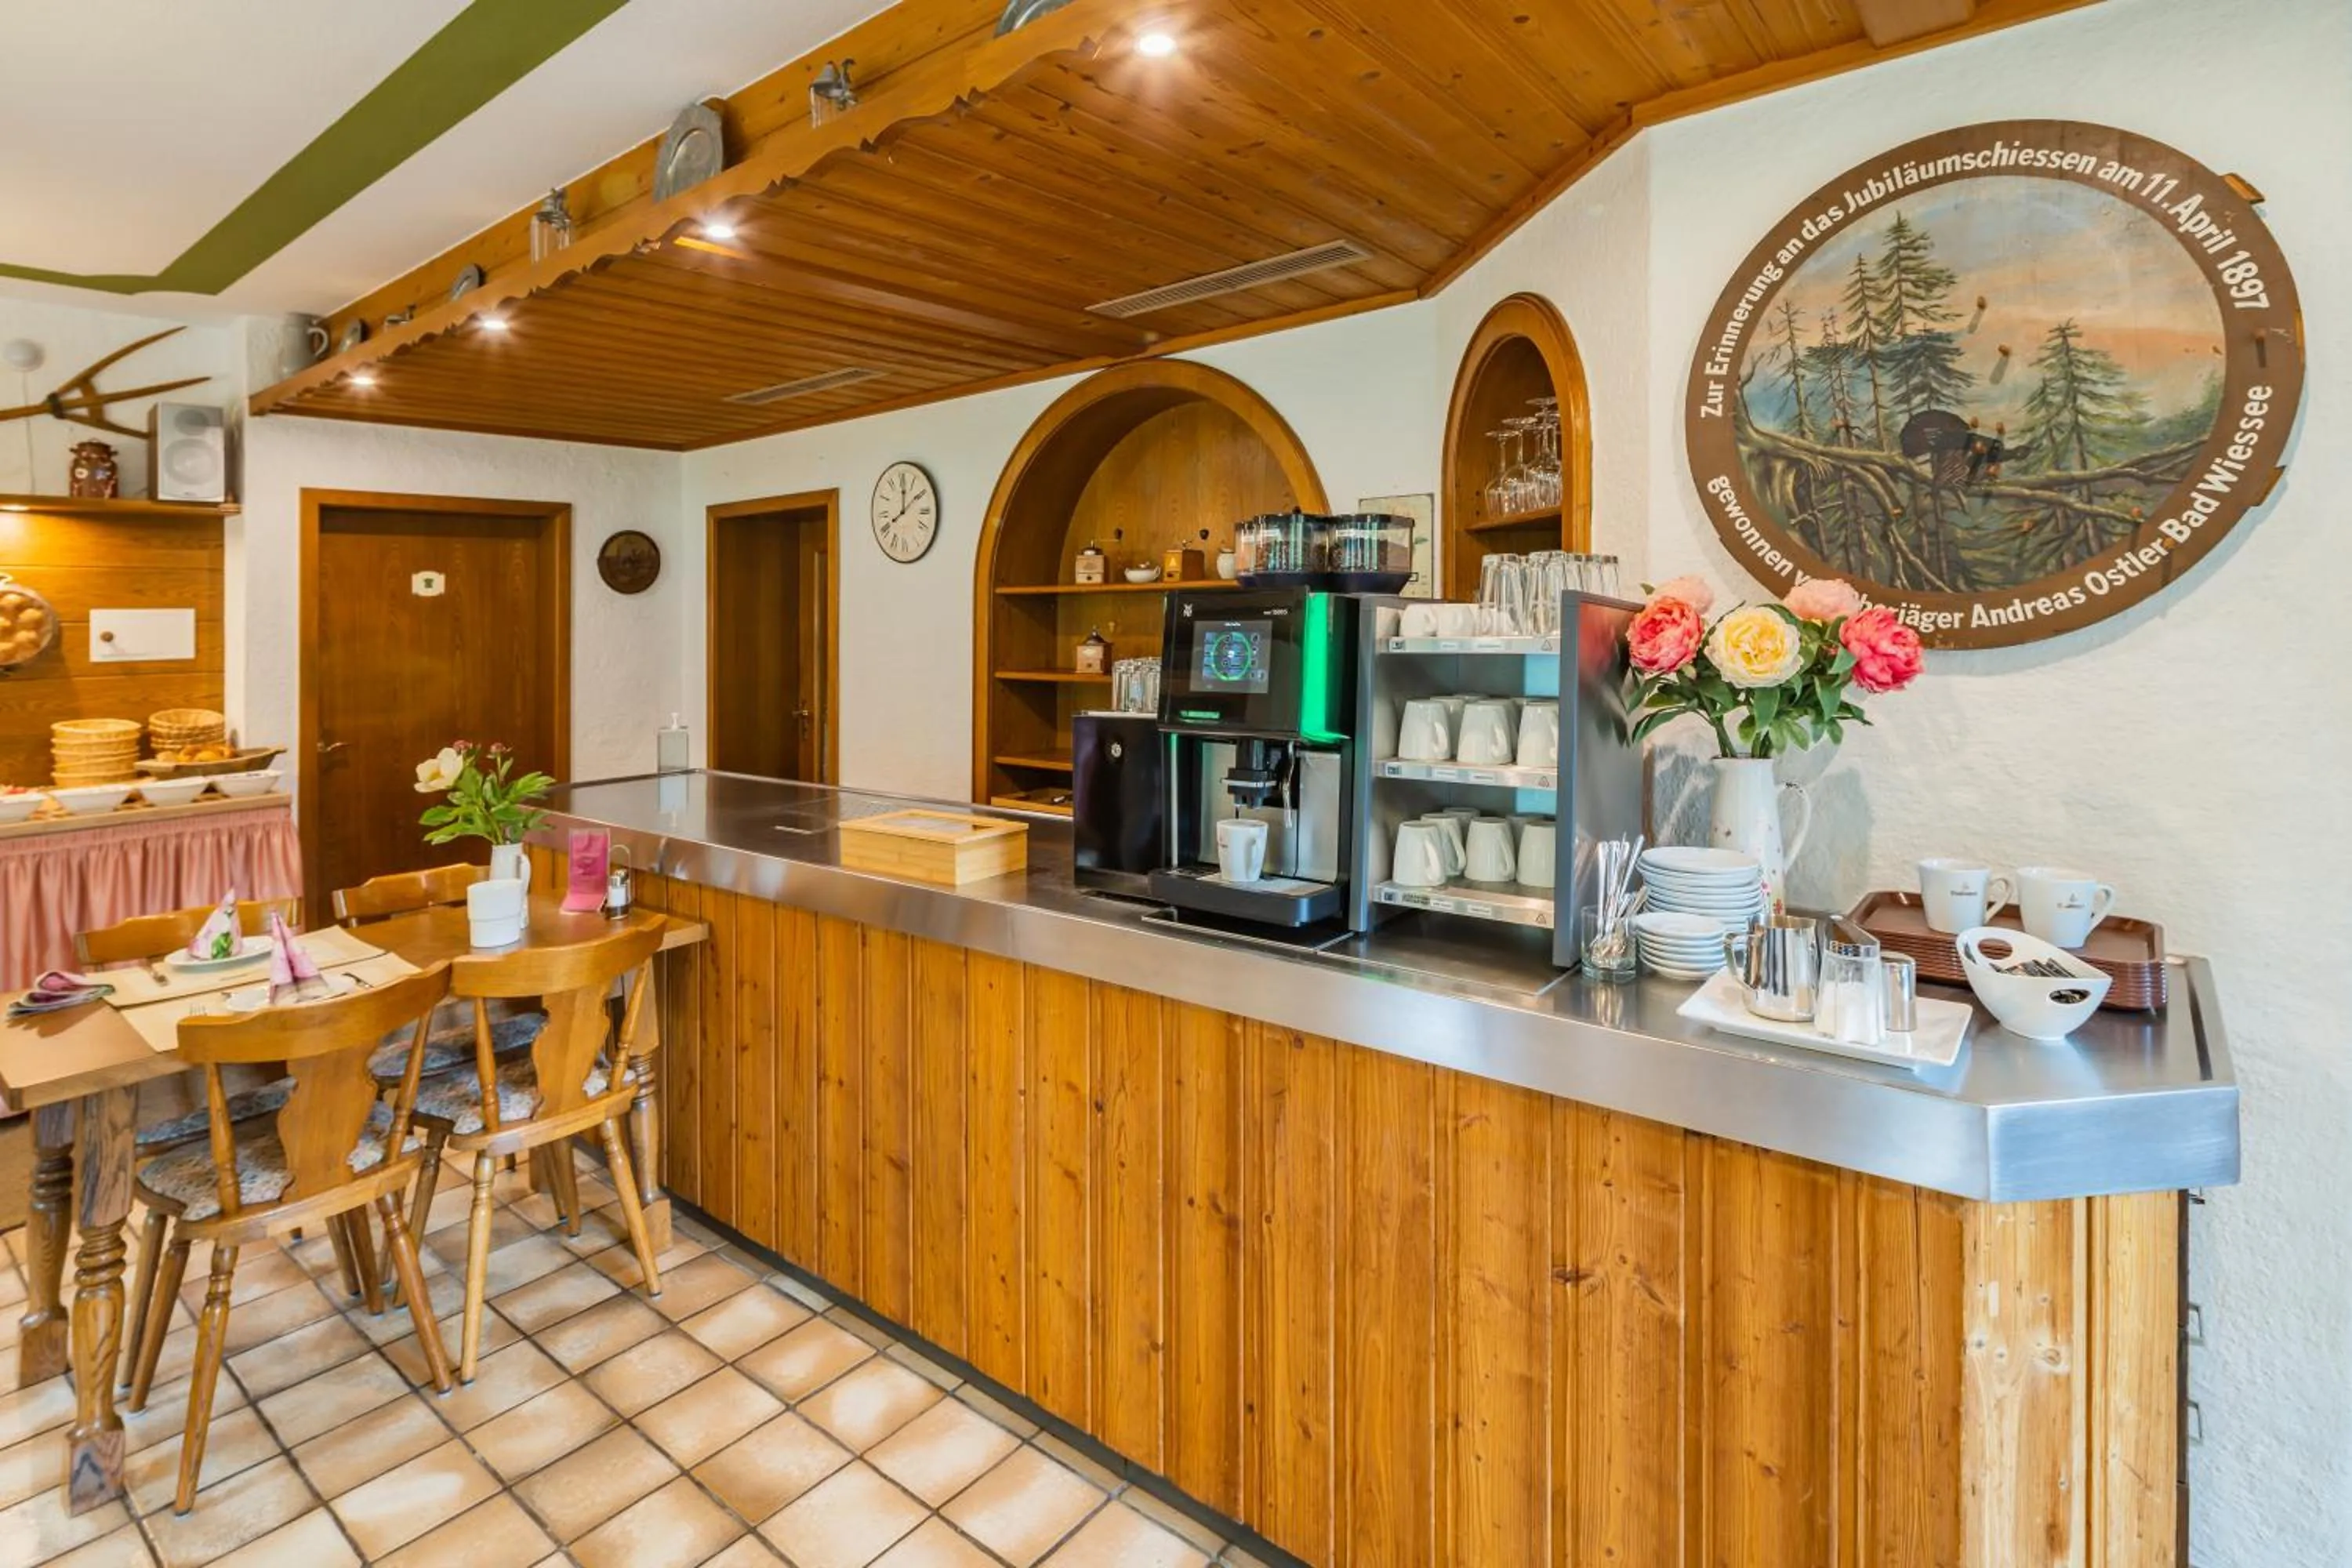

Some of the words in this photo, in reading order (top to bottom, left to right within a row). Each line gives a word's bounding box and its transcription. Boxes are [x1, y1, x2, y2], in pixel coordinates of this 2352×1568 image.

[1843, 140, 2098, 214] Jubiläumschiessen
[2097, 160, 2144, 191] am
[1776, 238, 1805, 265] an
[1801, 205, 1845, 241] das
[2167, 193, 2238, 255] April
[2217, 250, 2270, 308] 1897
[1704, 260, 1784, 376] Erinnerung
[1700, 381, 1725, 419] Zur
[1707, 474, 1795, 578] gewonnen
[1970, 583, 2086, 629] Andreas
[2084, 538, 2171, 597] Ostler
[2158, 492, 2221, 544] Bad
[2196, 385, 2274, 494] Wiessee
